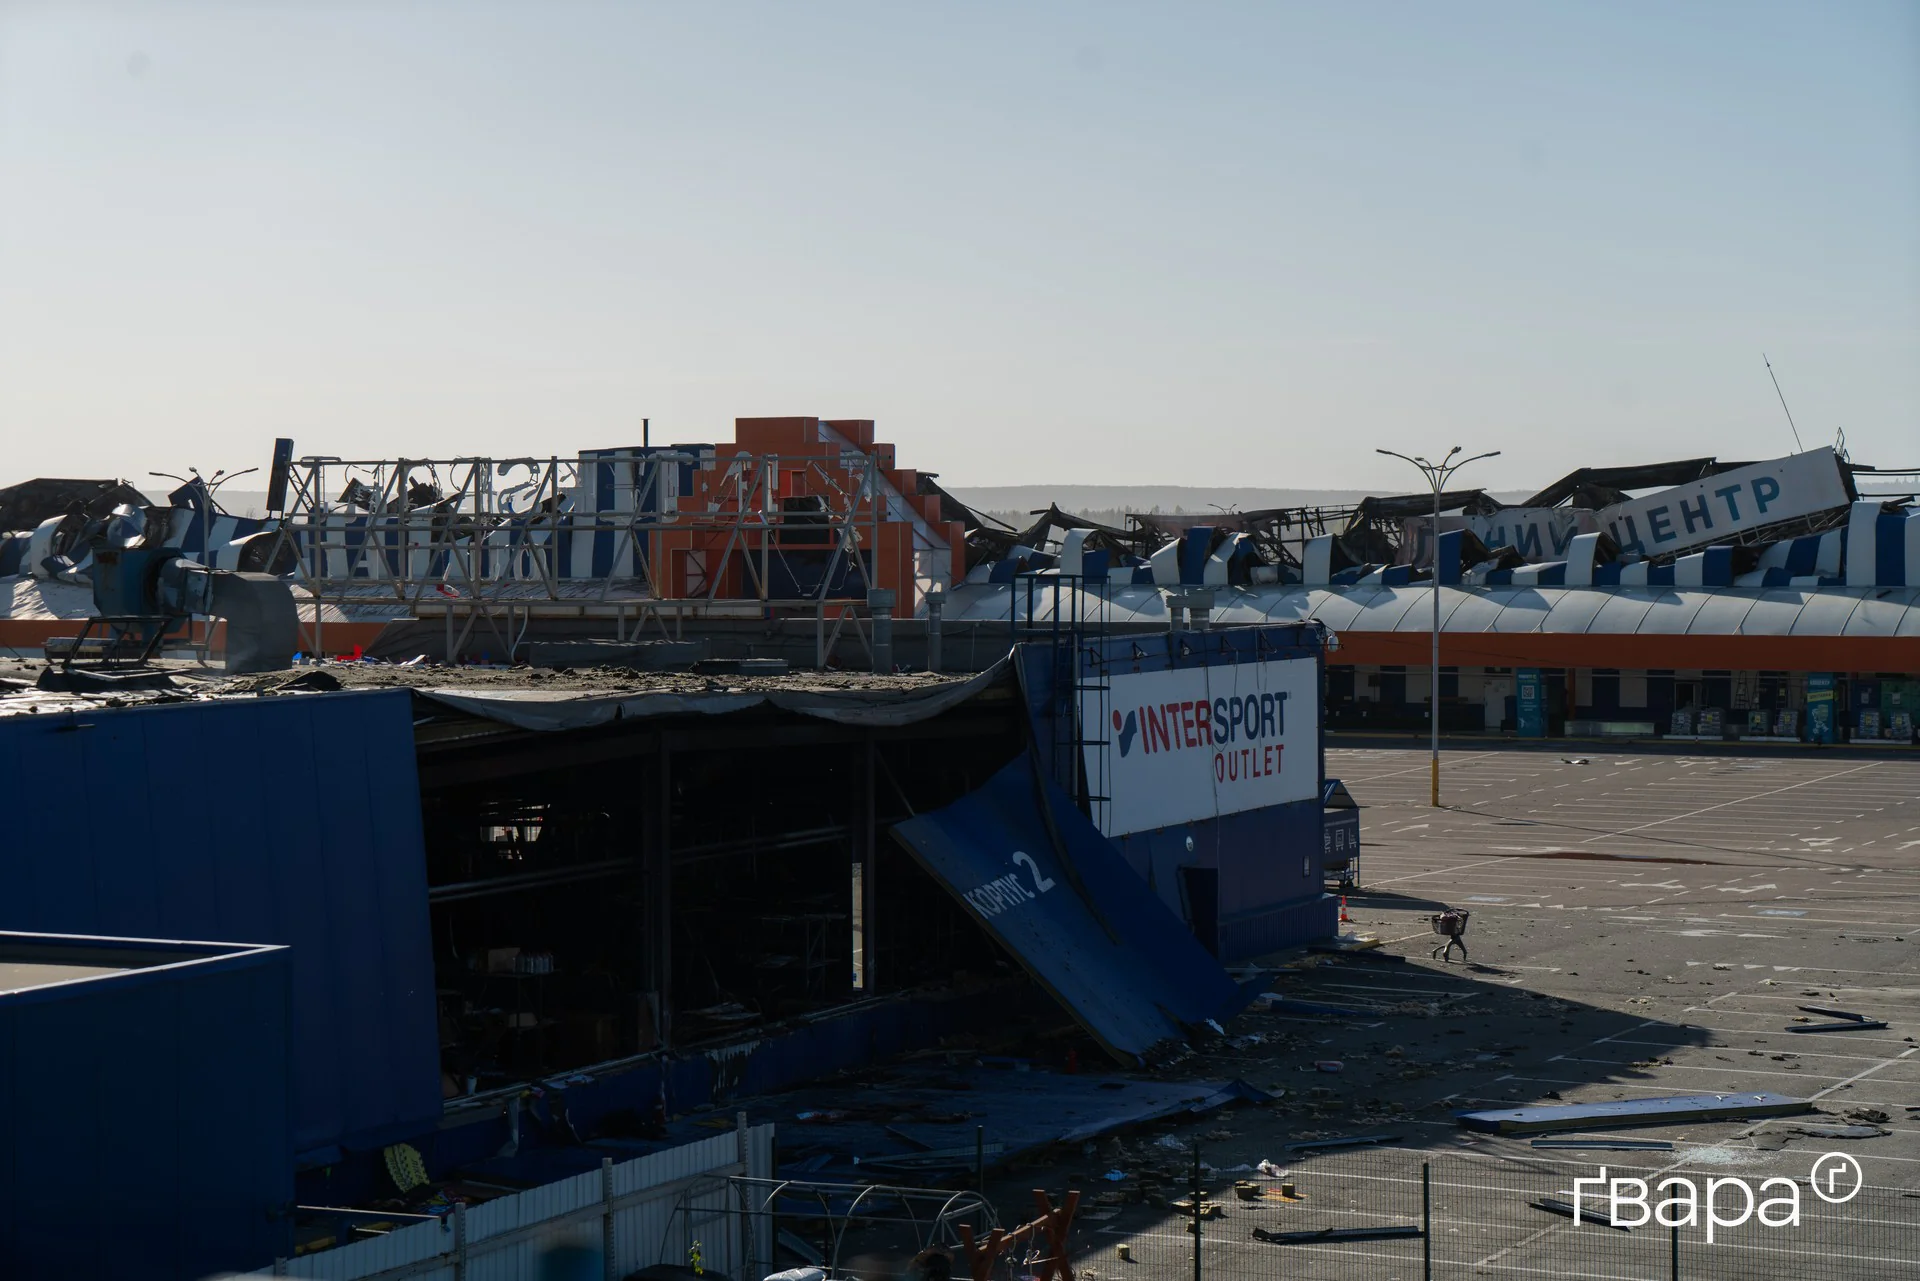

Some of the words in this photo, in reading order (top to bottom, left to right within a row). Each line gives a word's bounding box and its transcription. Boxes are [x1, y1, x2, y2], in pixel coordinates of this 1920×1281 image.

[1609, 476, 1780, 556] ЦЕНТР
[1139, 691, 1288, 754] INTERSPORT
[1214, 744, 1284, 784] OUTLET
[962, 872, 1036, 919] КОРПУС
[1012, 850, 1056, 893] 2
